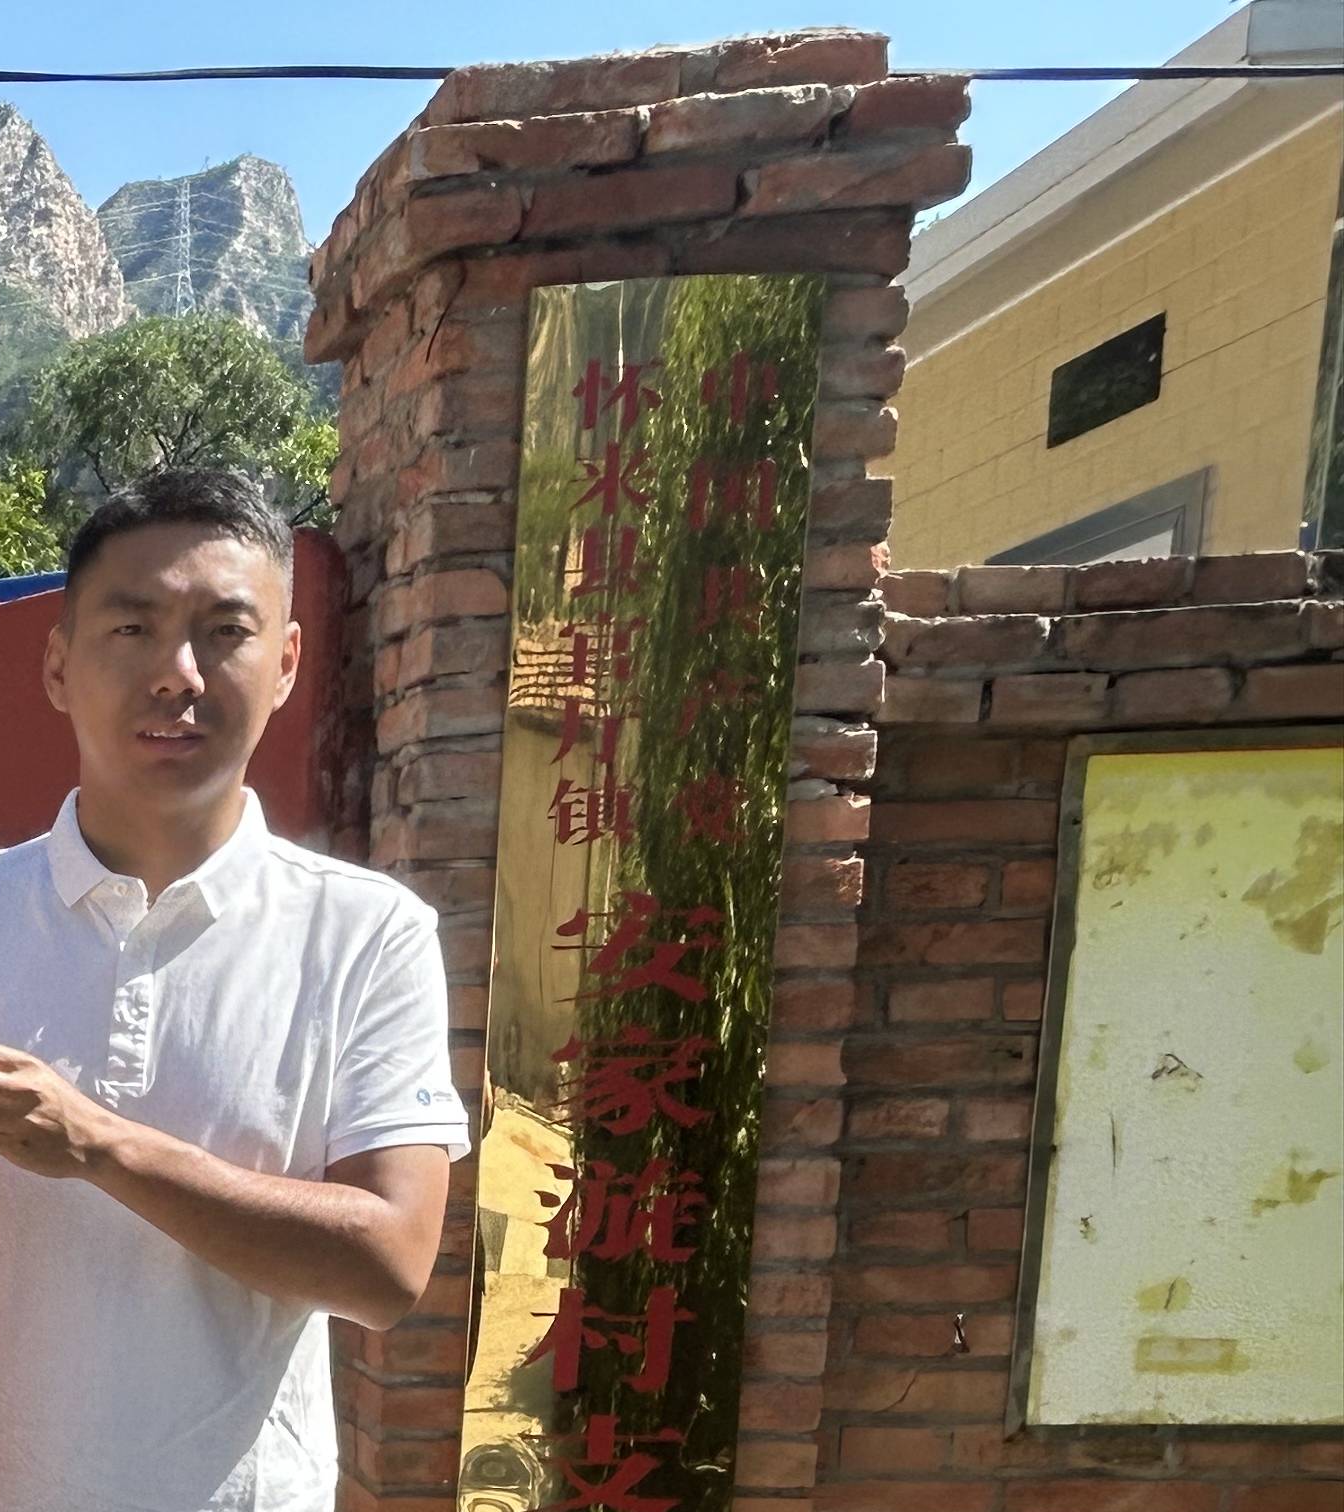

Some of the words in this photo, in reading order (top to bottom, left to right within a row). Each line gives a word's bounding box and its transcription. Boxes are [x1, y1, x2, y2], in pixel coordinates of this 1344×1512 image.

[548, 357, 664, 847] 怀来县官厅镇
